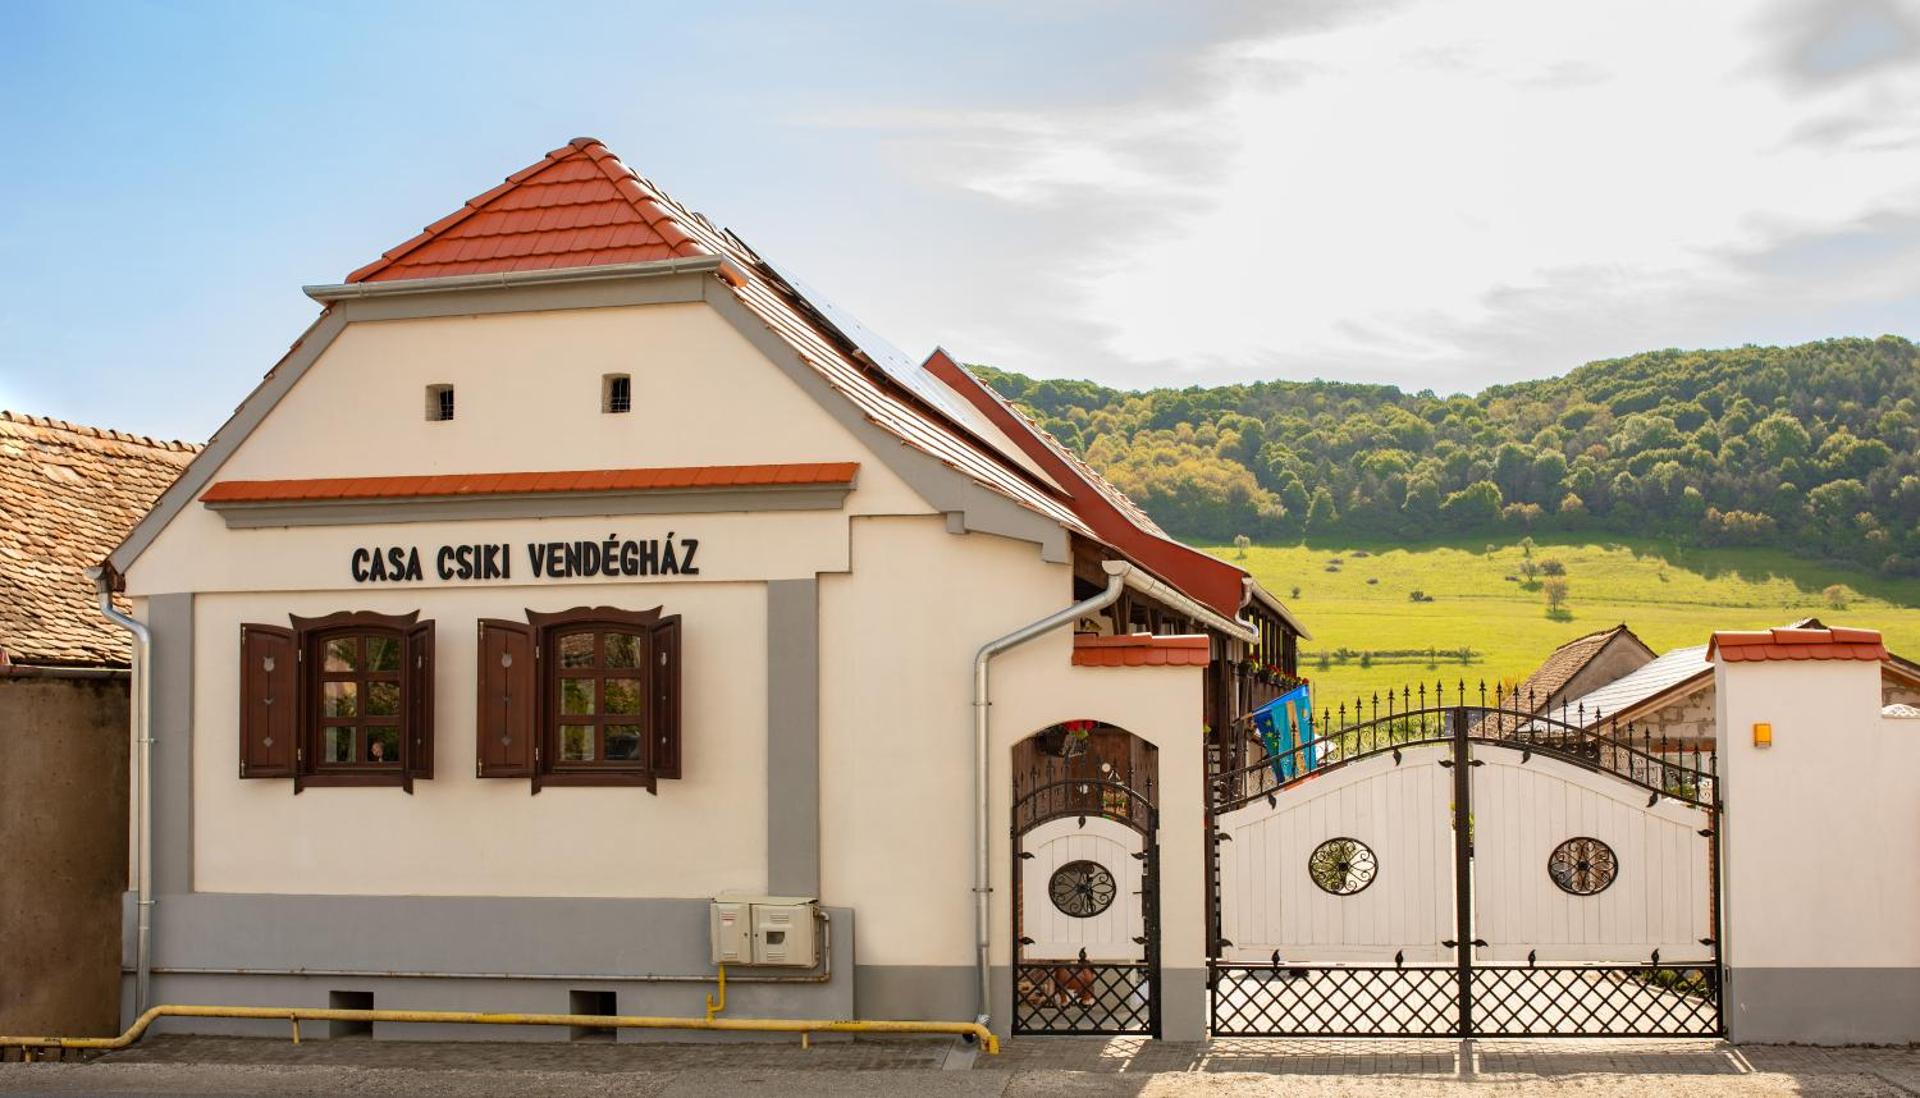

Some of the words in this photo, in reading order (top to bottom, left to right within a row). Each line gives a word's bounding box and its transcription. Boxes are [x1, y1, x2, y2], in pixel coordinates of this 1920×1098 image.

[352, 547, 423, 582] CASA
[437, 544, 511, 580] CSIKI
[528, 532, 700, 578] VENDÉGHÁZ
